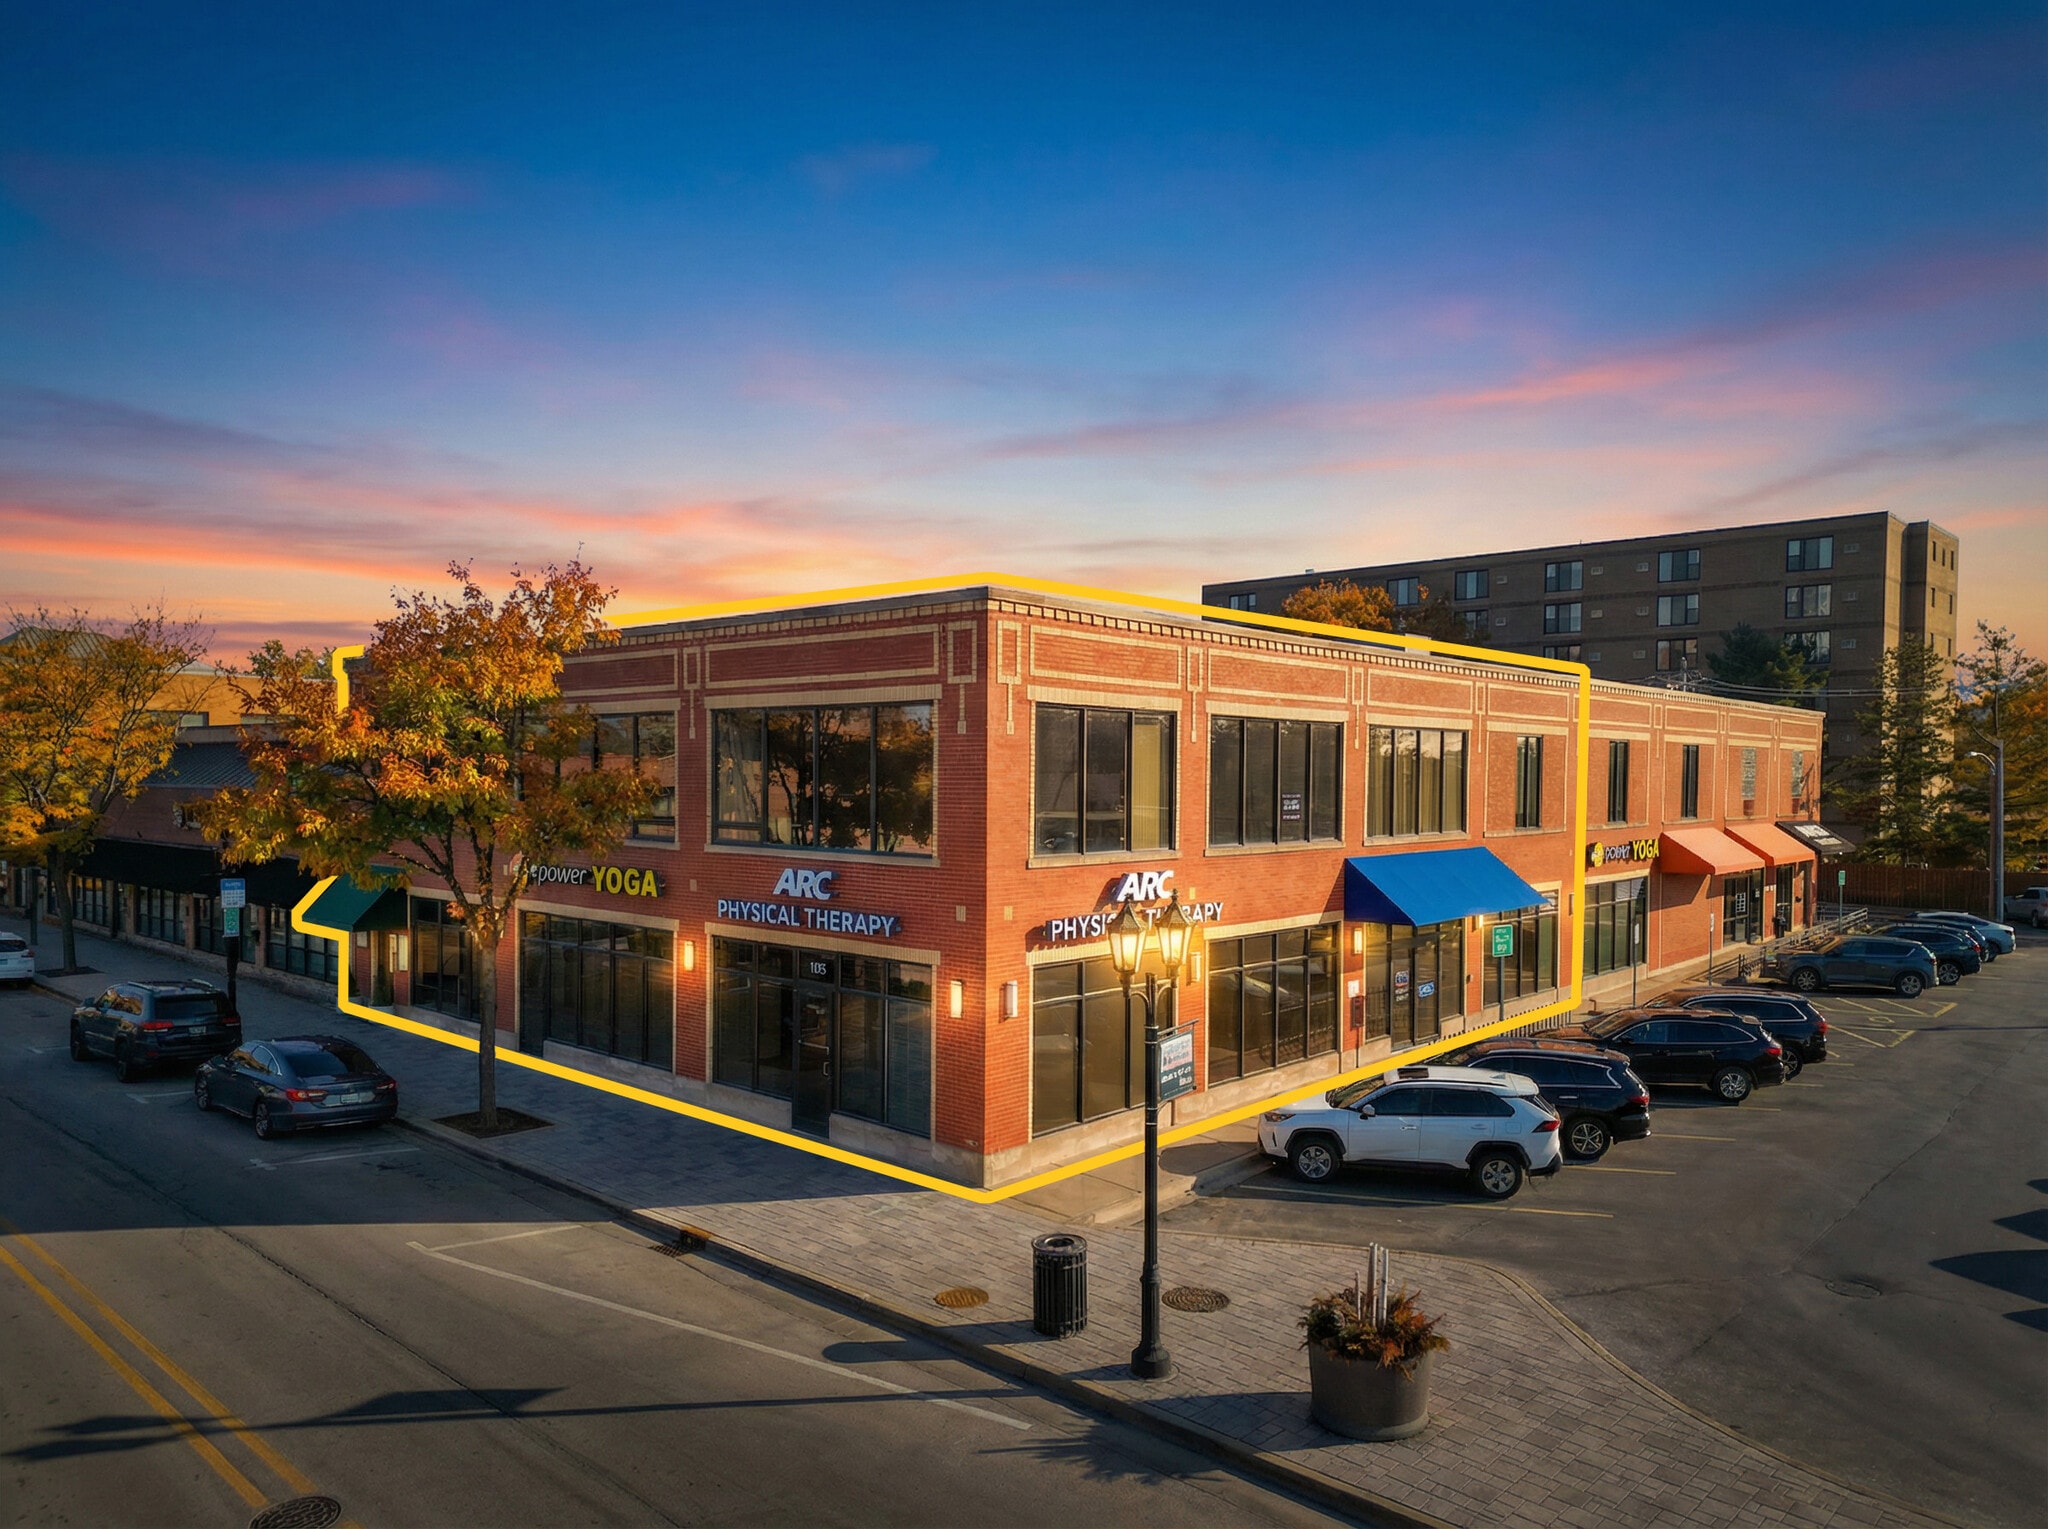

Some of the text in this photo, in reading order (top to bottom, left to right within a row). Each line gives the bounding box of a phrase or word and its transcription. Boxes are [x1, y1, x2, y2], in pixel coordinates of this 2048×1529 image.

[1632, 838, 1660, 861] YOGA
[538, 865, 658, 898] power YOGA
[773, 868, 832, 900] ARC
[1117, 870, 1174, 902] ARC
[717, 899, 895, 938] PHYSICAL THERAPY
